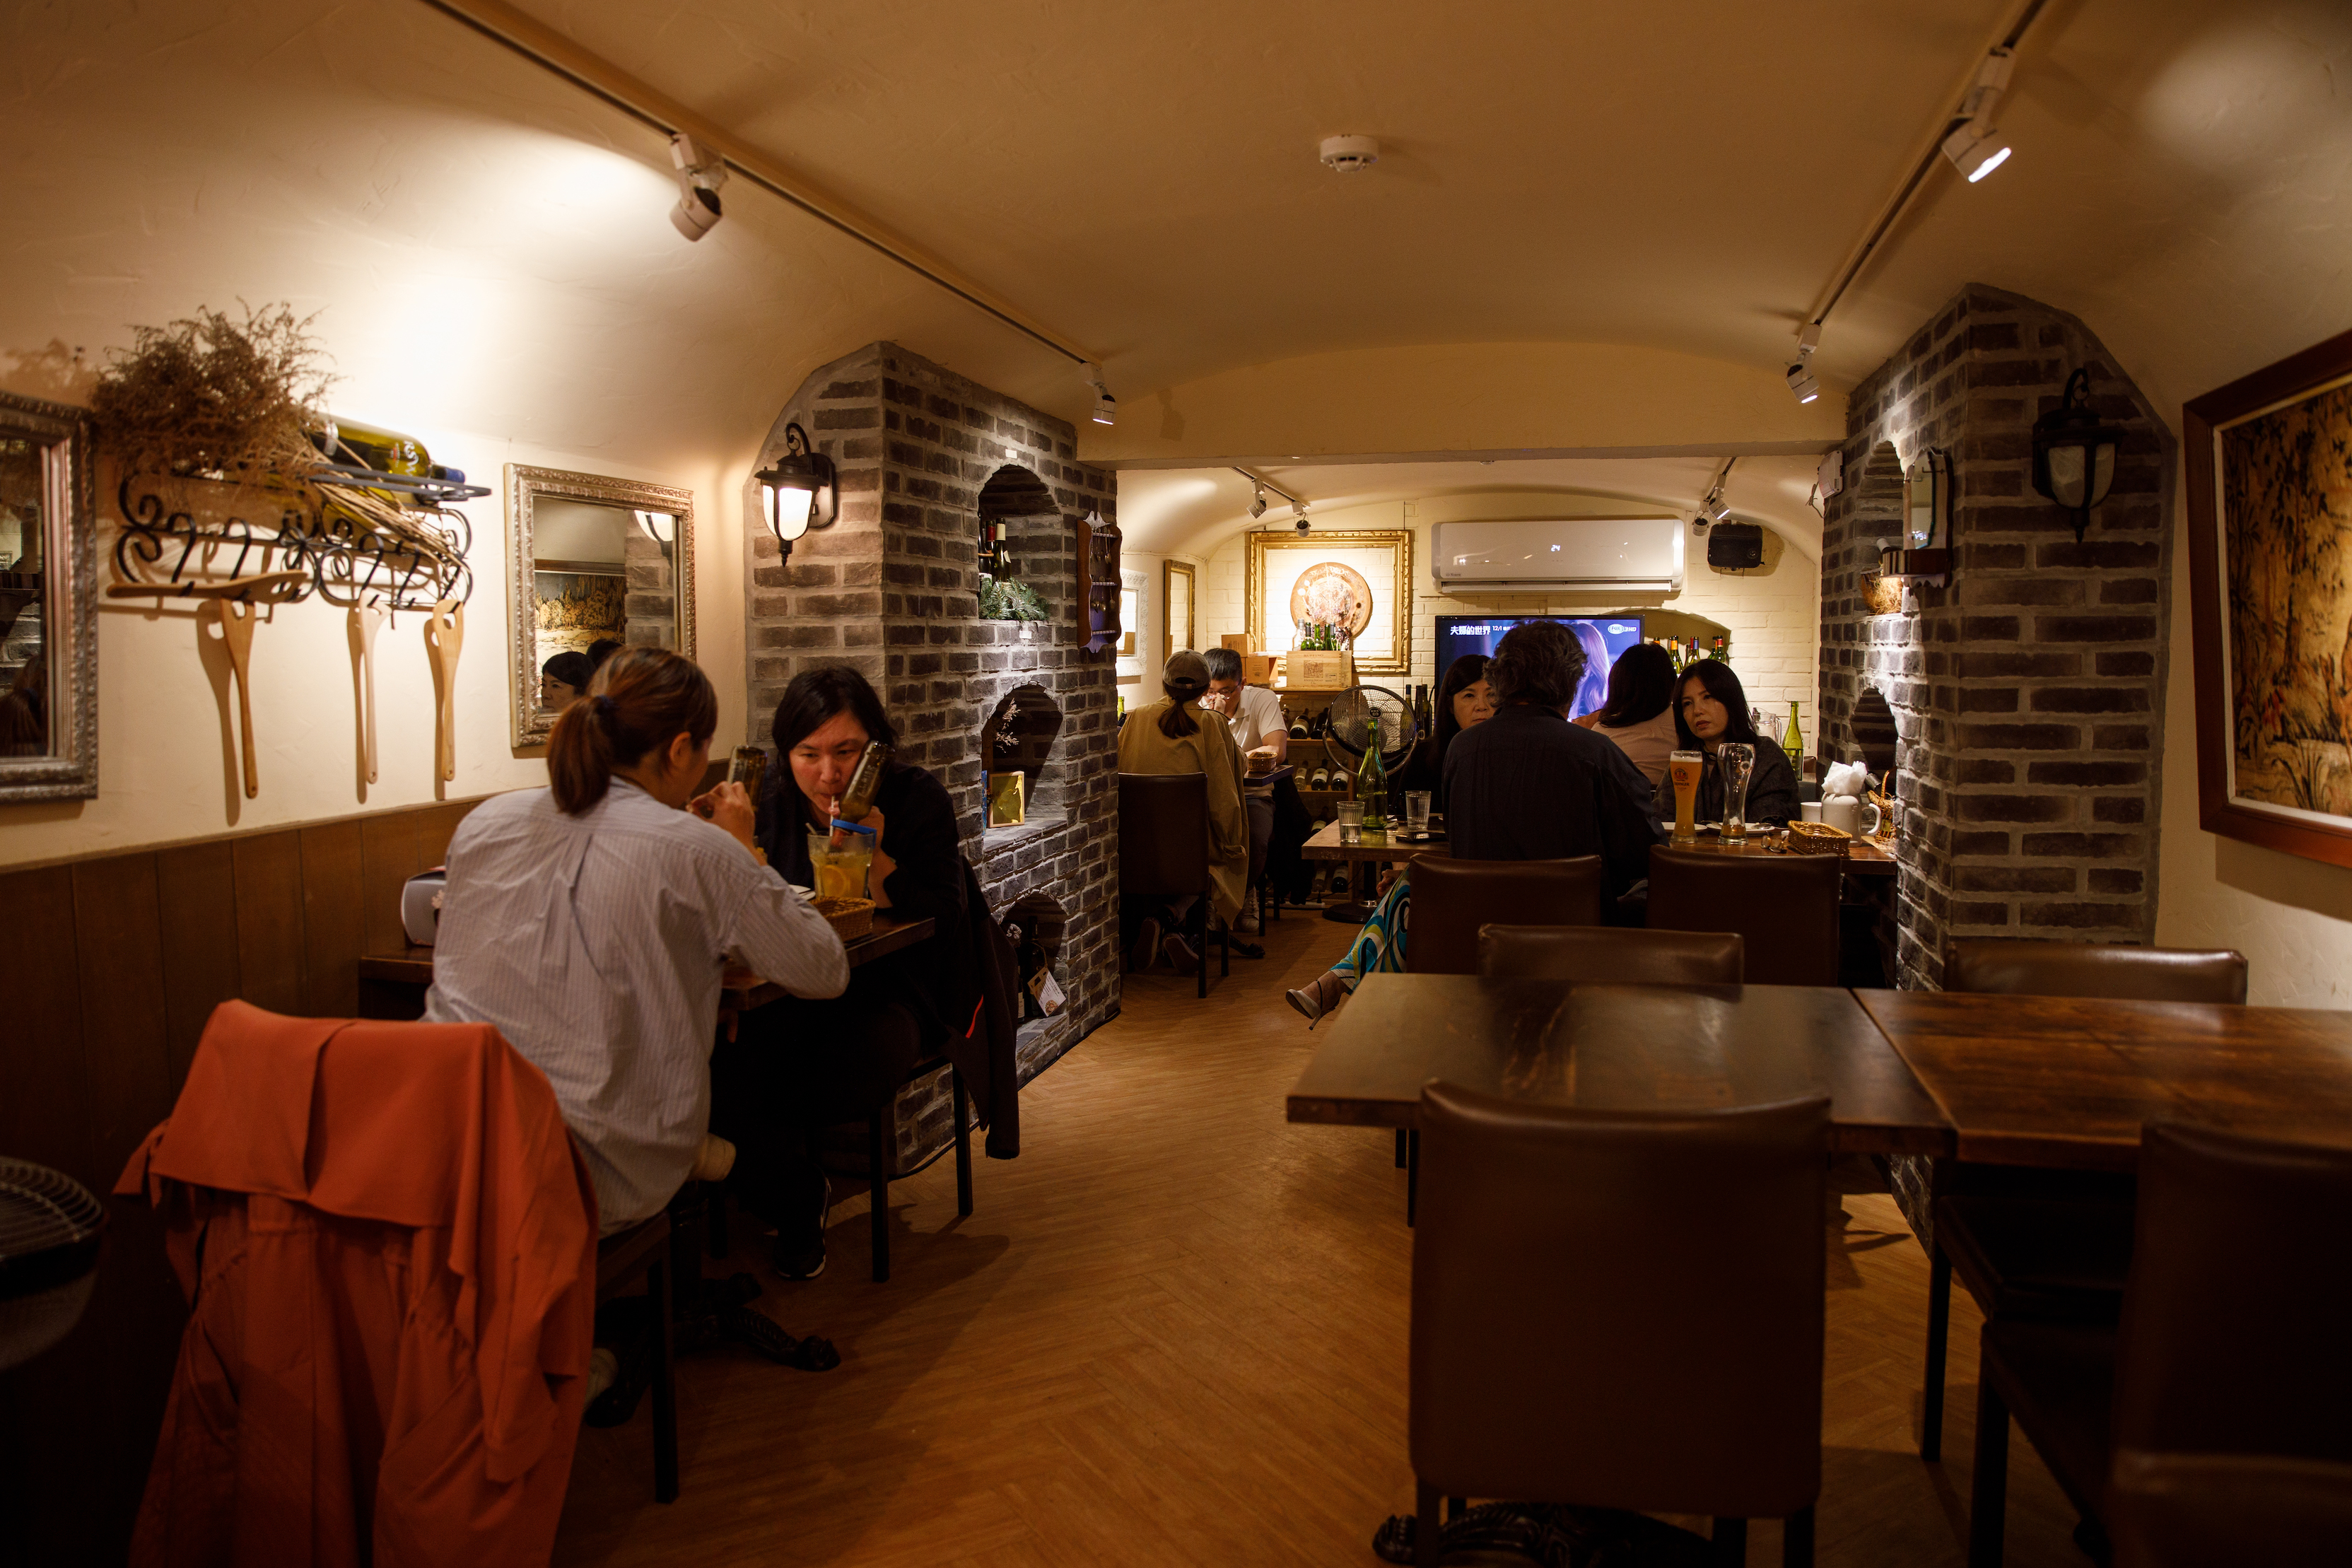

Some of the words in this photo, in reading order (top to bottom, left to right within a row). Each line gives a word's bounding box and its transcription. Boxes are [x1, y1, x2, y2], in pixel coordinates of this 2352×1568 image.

[1450, 625, 1490, 635] 夫婦的世界
